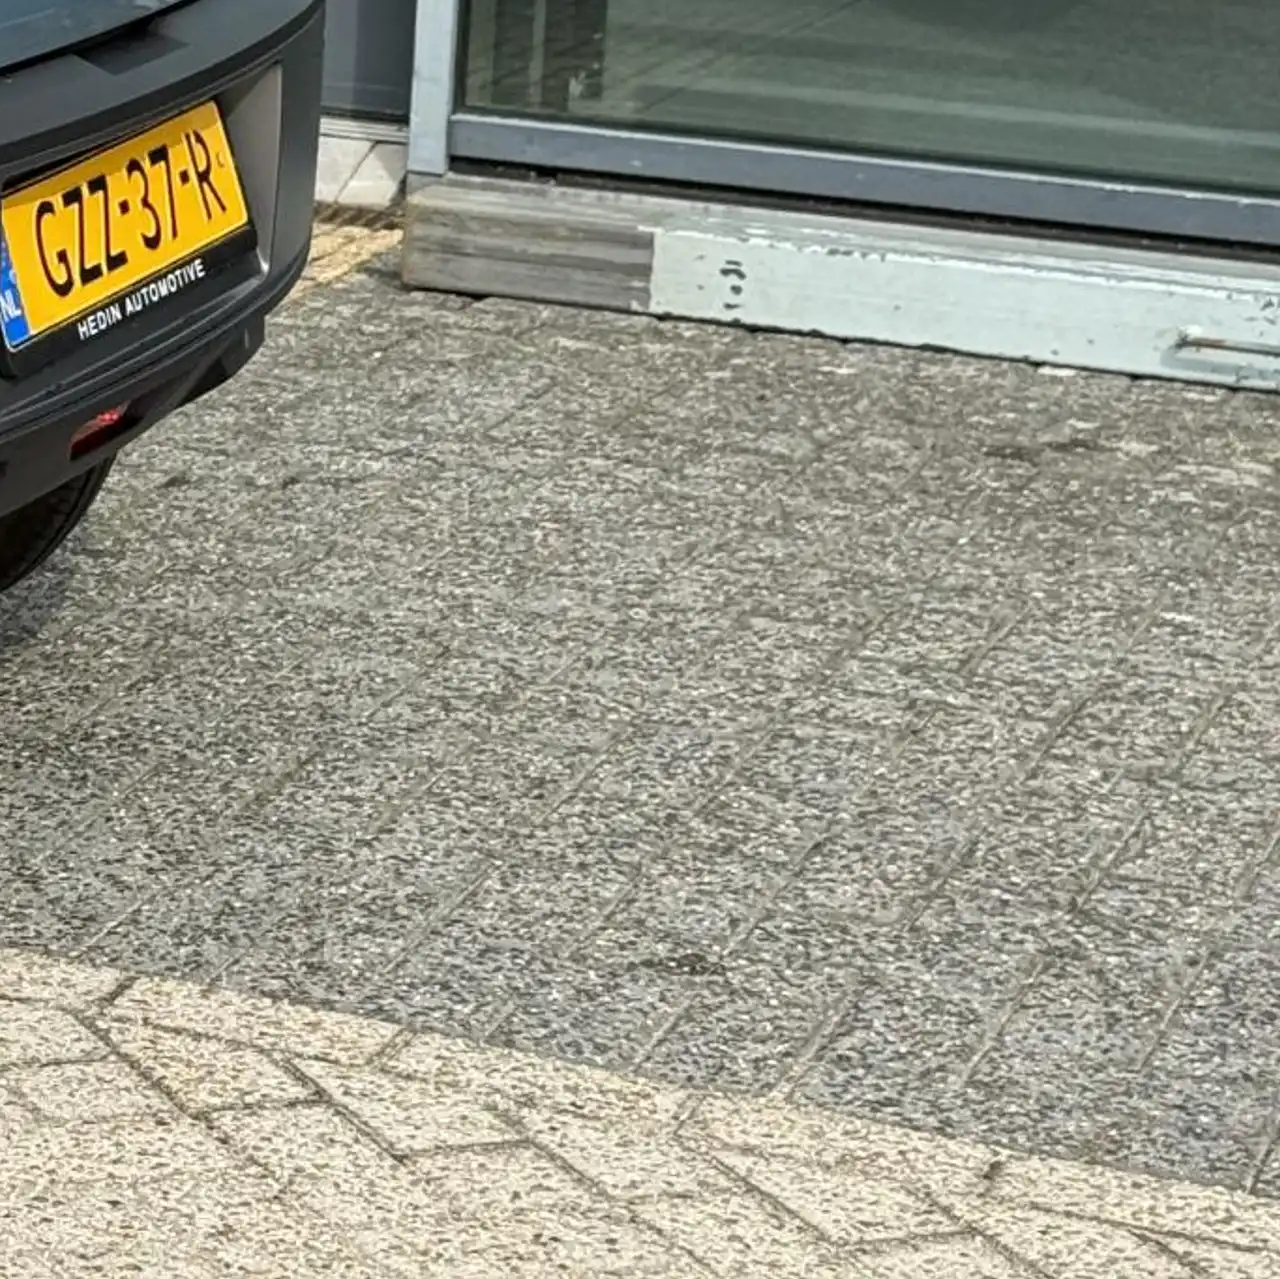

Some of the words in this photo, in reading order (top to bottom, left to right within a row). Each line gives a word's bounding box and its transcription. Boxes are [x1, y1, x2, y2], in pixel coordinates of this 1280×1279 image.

[34, 129, 227, 298] GZZ-37-R
[76, 305, 123, 341] HEDIN
[125, 258, 206, 317] AUTOMOTIVE
